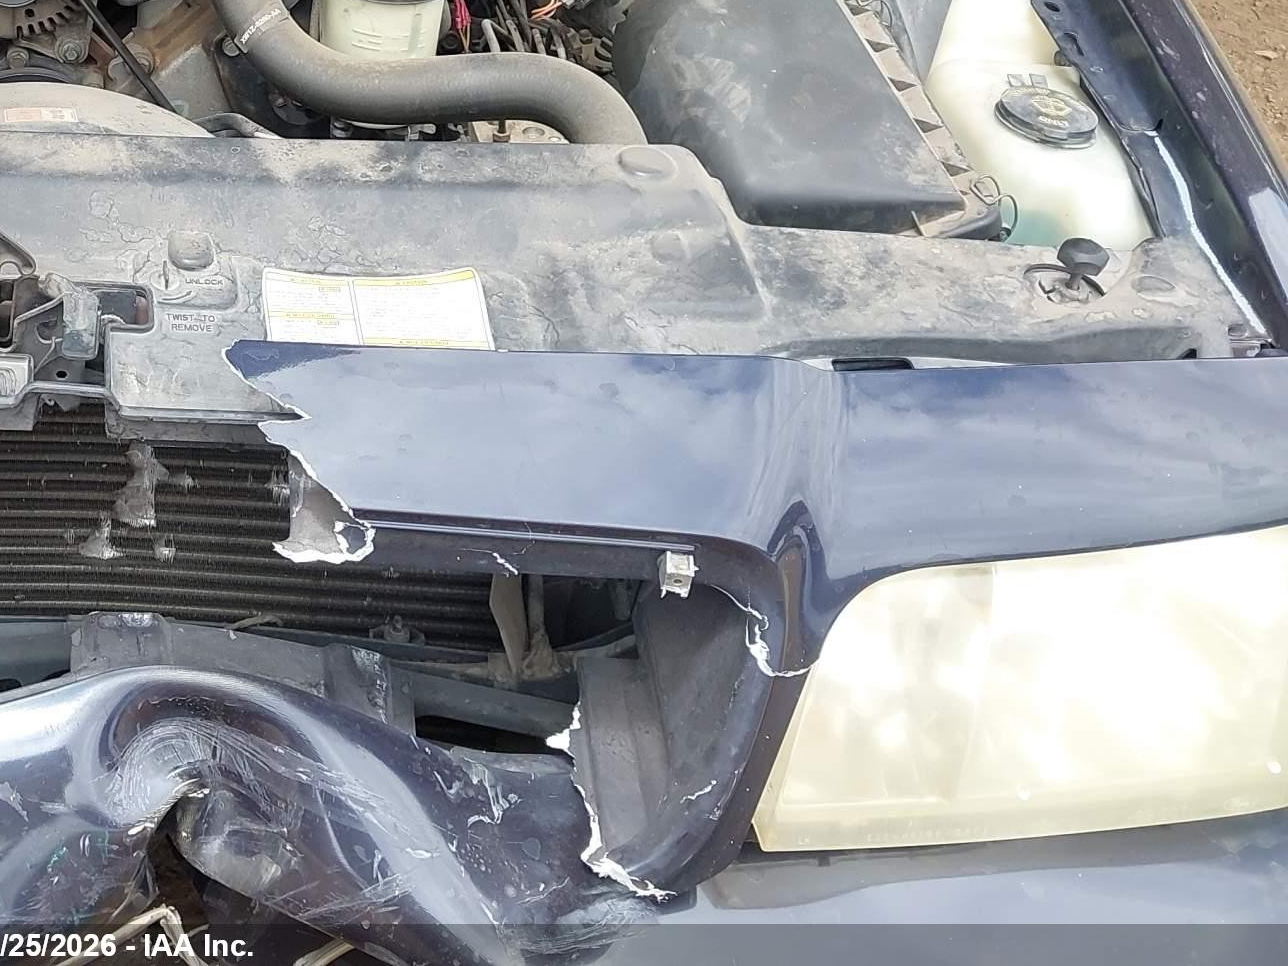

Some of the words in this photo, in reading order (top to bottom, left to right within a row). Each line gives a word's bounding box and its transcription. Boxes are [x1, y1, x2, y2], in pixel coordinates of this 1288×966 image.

[185, 278, 224, 286] UNLOCK
[167, 313, 195, 322] TWIST
[200, 314, 216, 323] TO
[171, 323, 213, 332] REMOVE
